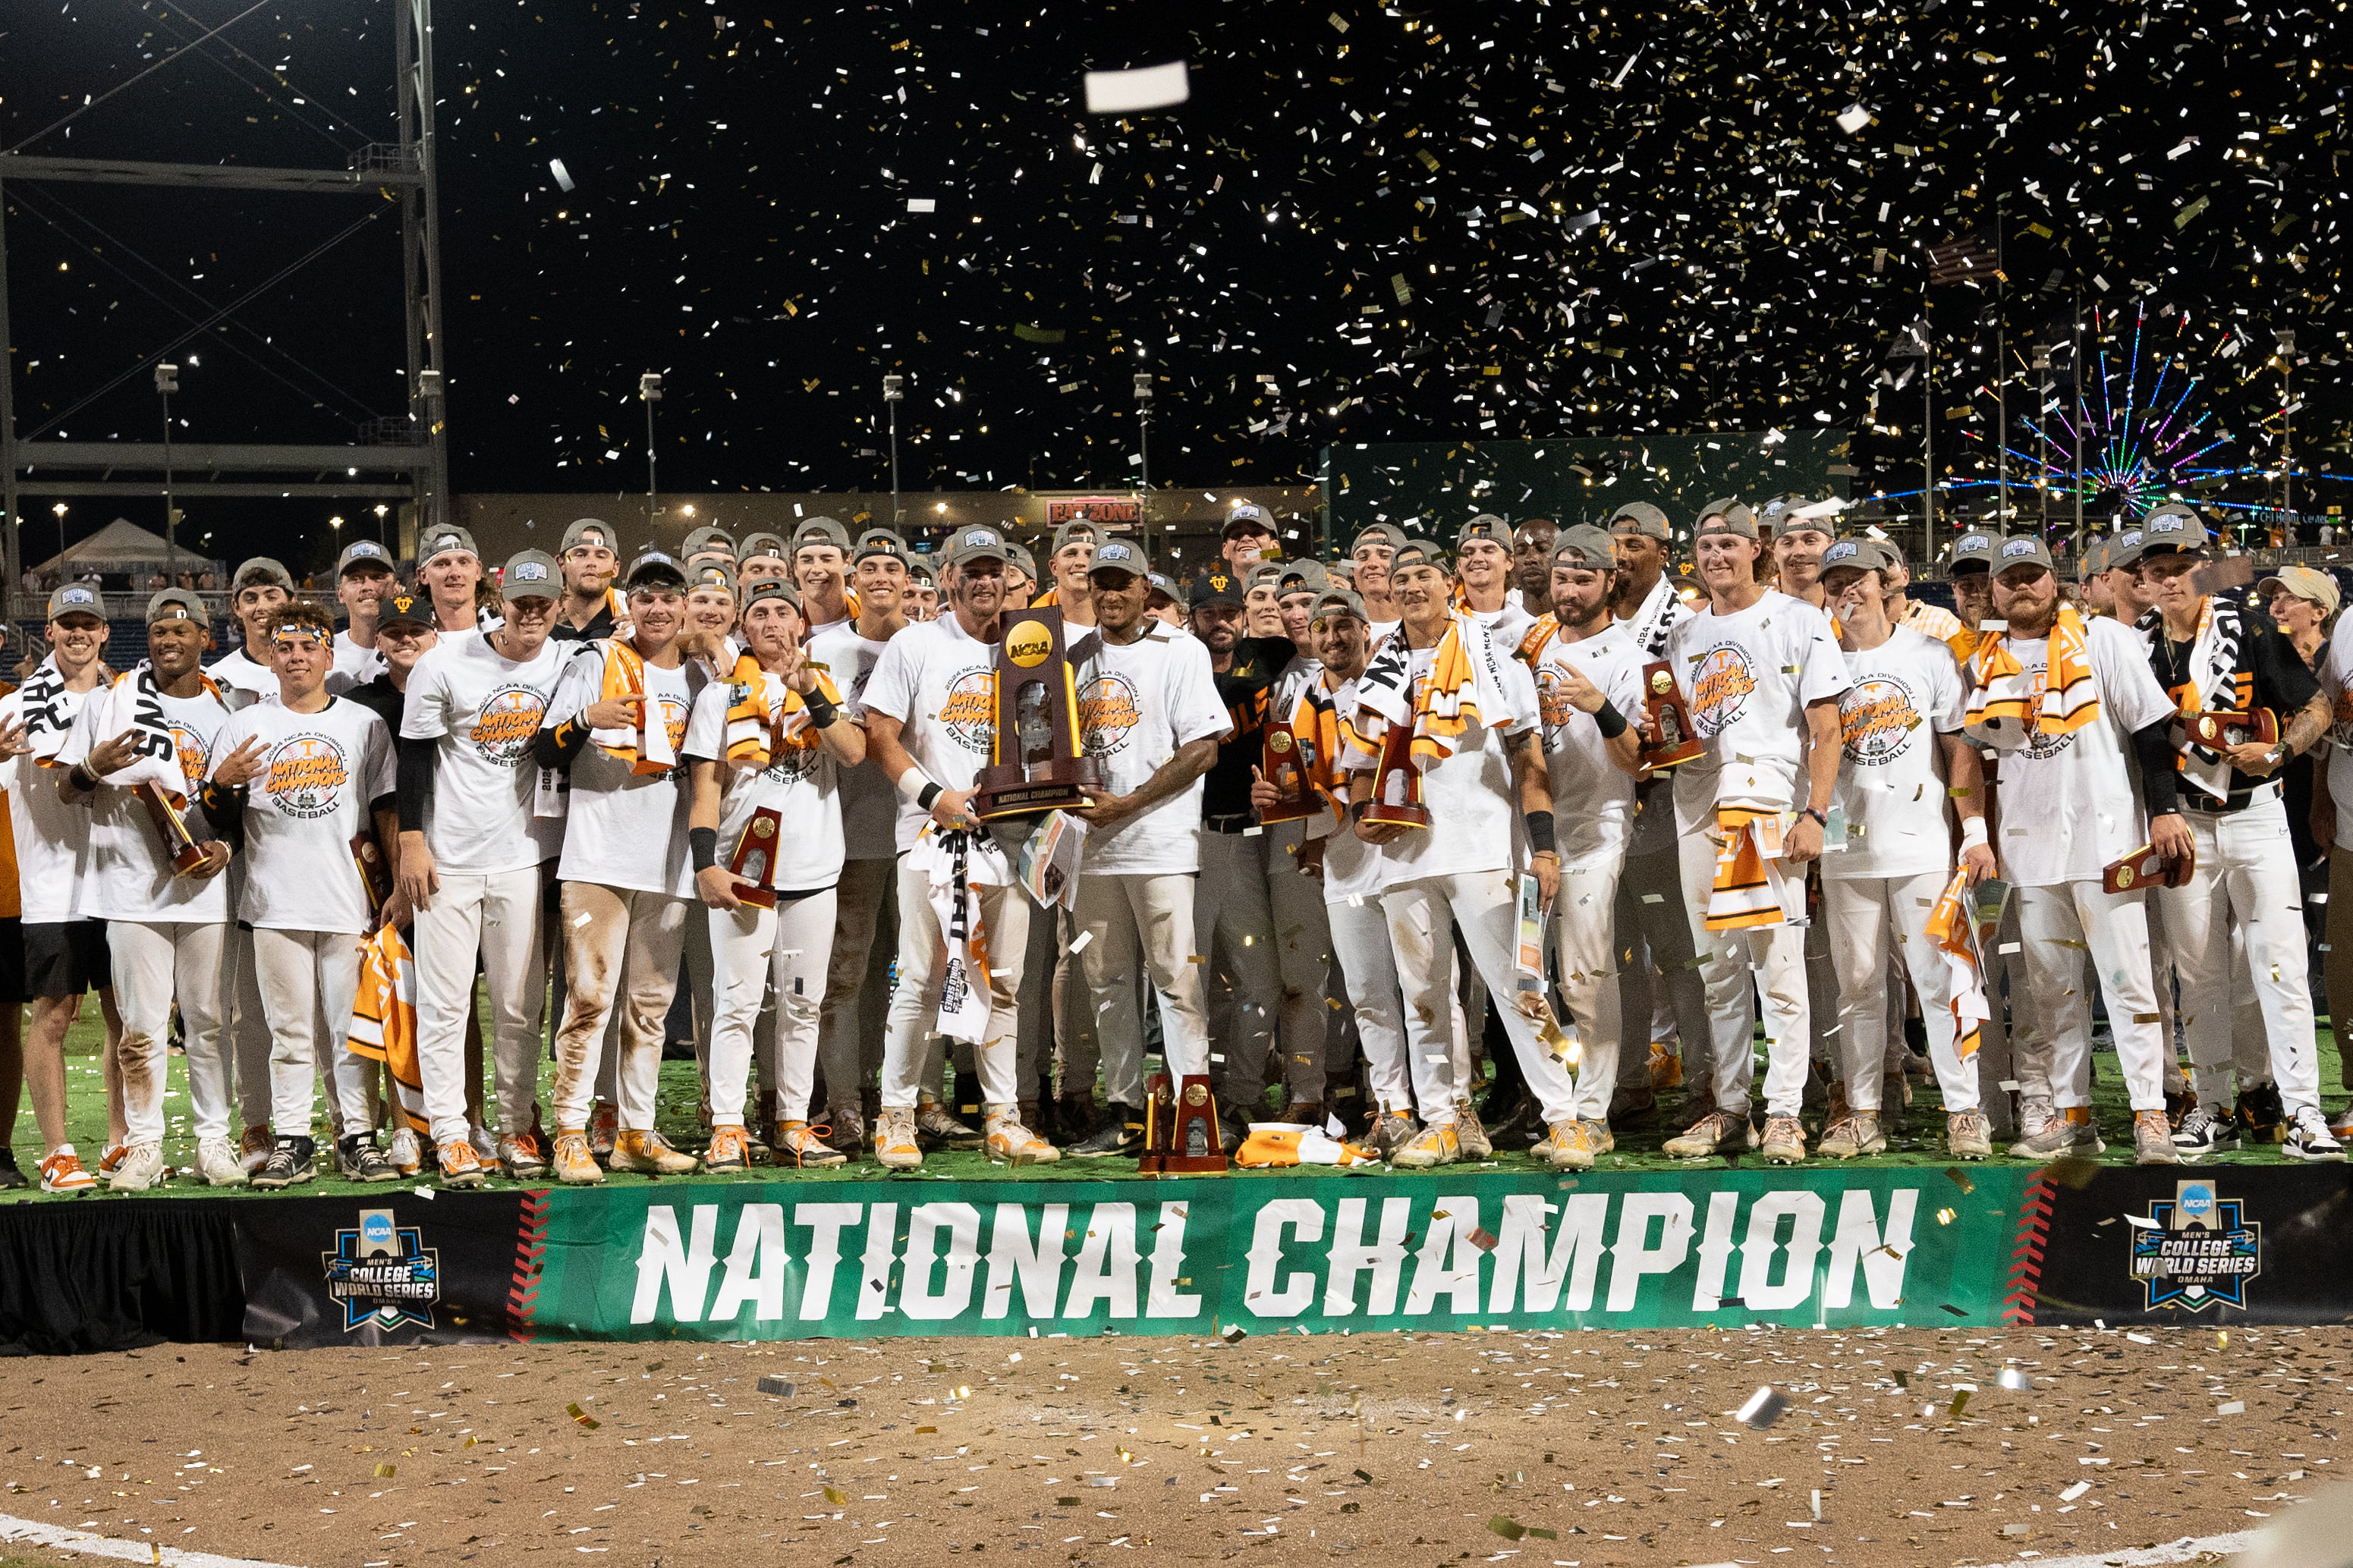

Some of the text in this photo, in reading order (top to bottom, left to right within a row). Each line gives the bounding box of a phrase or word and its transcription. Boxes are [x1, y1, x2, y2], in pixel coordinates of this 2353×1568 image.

[1052, 504, 1138, 521] EAT ZONE
[2276, 511, 2299, 523] Helth
[2003, 539, 2036, 555] CHAMPIONS
[1010, 640, 1049, 658] NCAA
[1725, 640, 1754, 665] DIVISION
[944, 665, 989, 690] 2024 NCAA
[1115, 671, 1139, 698] DIVISION
[1877, 672, 1913, 694] DIVISION
[492, 683, 520, 694] NCAA
[266, 741, 283, 762] 2024
[284, 731, 311, 742] NCAA
[314, 731, 347, 757] DIVISION
[1081, 743, 1129, 759] SEBALL
[1842, 743, 1912, 766] BASEBALL
[2018, 734, 2077, 759] ASEBALL
[272, 753, 341, 779] NATIONAL
[266, 770, 349, 795] CHAMPIONS
[998, 787, 1069, 804] NATIONAL CHAMPION
[272, 797, 341, 819] BASEBALL
[943, 959, 961, 1013] WORLD SERIES
[2183, 1199, 2211, 1208] NCAA
[366, 1227, 392, 1236] NCAA
[629, 1188, 1920, 1324] NATIONAL CHAMPION
[2160, 1240, 2232, 1256] COLLEGE
[366, 1258, 393, 1266] MEN'S
[2136, 1257, 2256, 1274] WRLD SERIES
[350, 1266, 412, 1283] COLLEGE
[2177, 1275, 2213, 1284] OMAHA
[335, 1282, 434, 1299] WORLD SERIES
